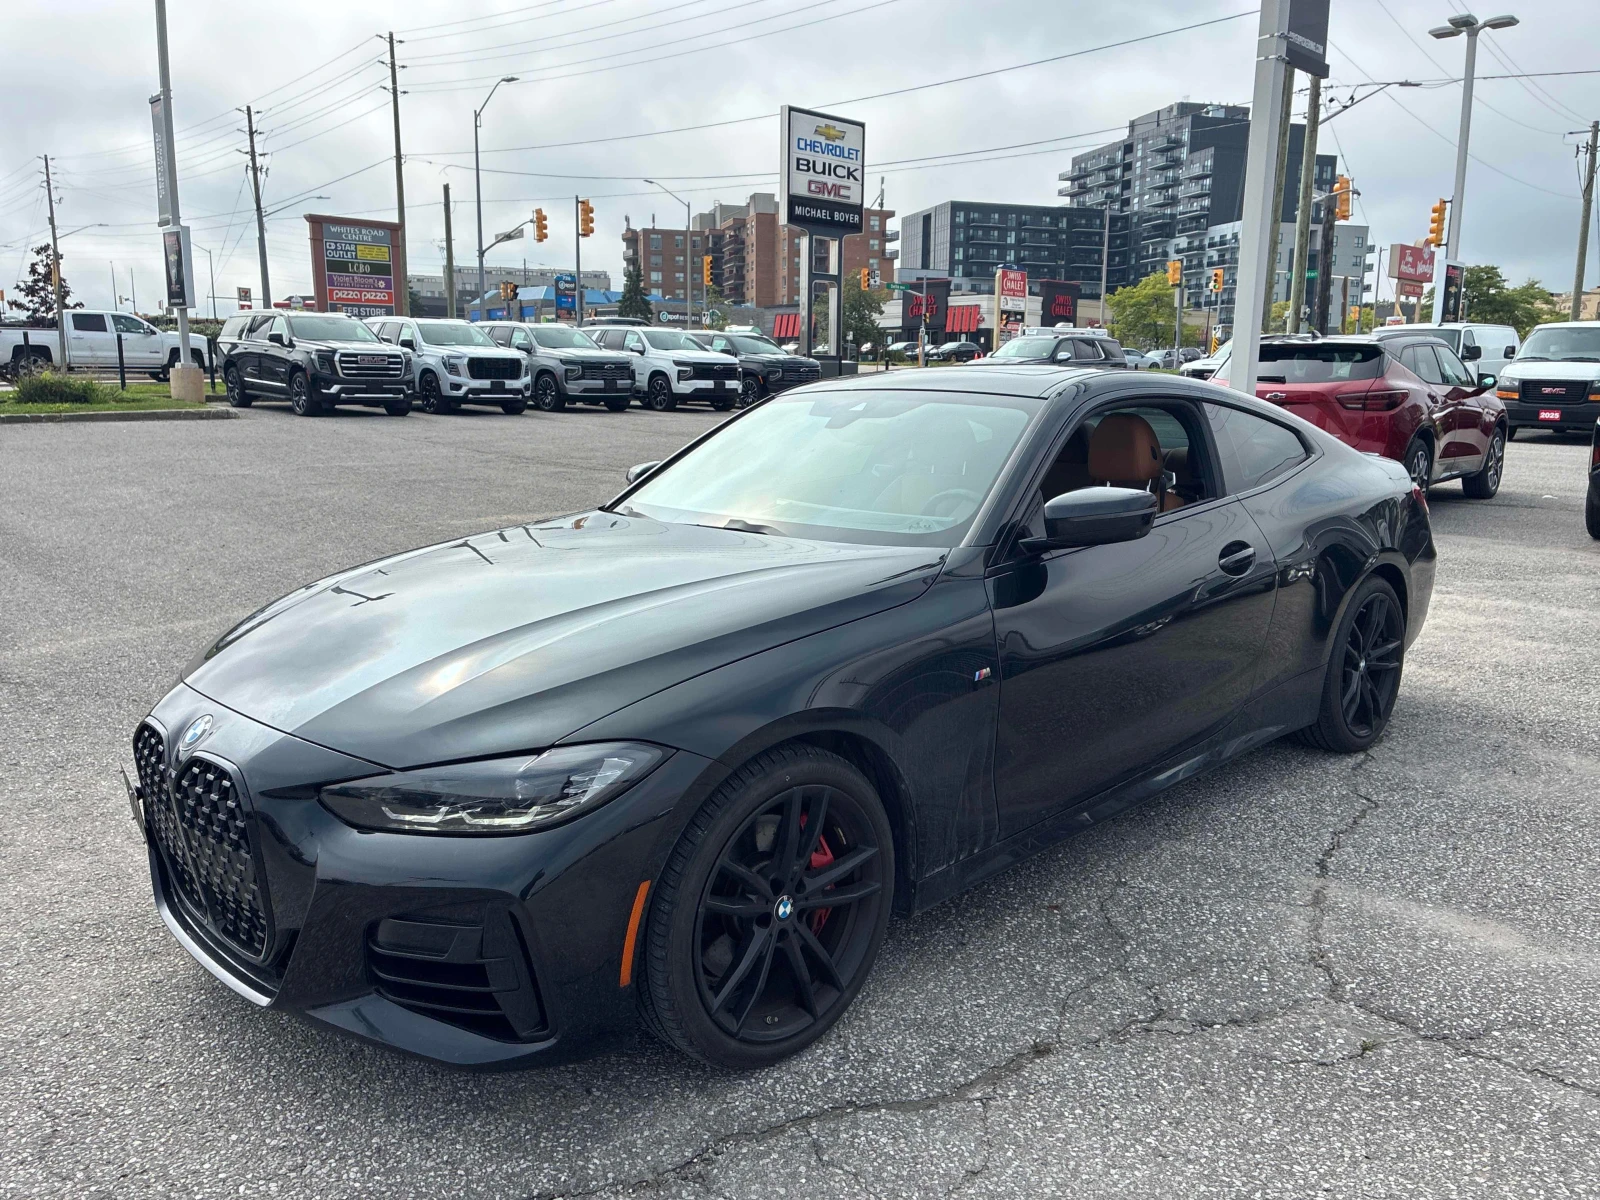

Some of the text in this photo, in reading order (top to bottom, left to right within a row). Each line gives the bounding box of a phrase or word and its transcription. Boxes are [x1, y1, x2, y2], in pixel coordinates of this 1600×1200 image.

[797, 137, 860, 161] CHEVROLET
[796, 157, 860, 182] BUICK
[808, 179, 851, 200] GMC
[795, 206, 860, 223] MICHAEL BOYER
[330, 226, 384, 237] WHITES ROAD
[342, 234, 372, 242] CENTRE
[336, 243, 356, 251] STAR
[326, 250, 356, 259] OUTLET
[348, 263, 371, 273] LCBO
[1007, 271, 1022, 281] SWISS
[1003, 277, 1025, 291] CHALET
[333, 290, 388, 302] pizza pizza
[1055, 294, 1072, 306] SWISS
[360, 307, 387, 316] STORE
[1051, 303, 1073, 317] CHALET
[1540, 411, 1560, 419] 2025
